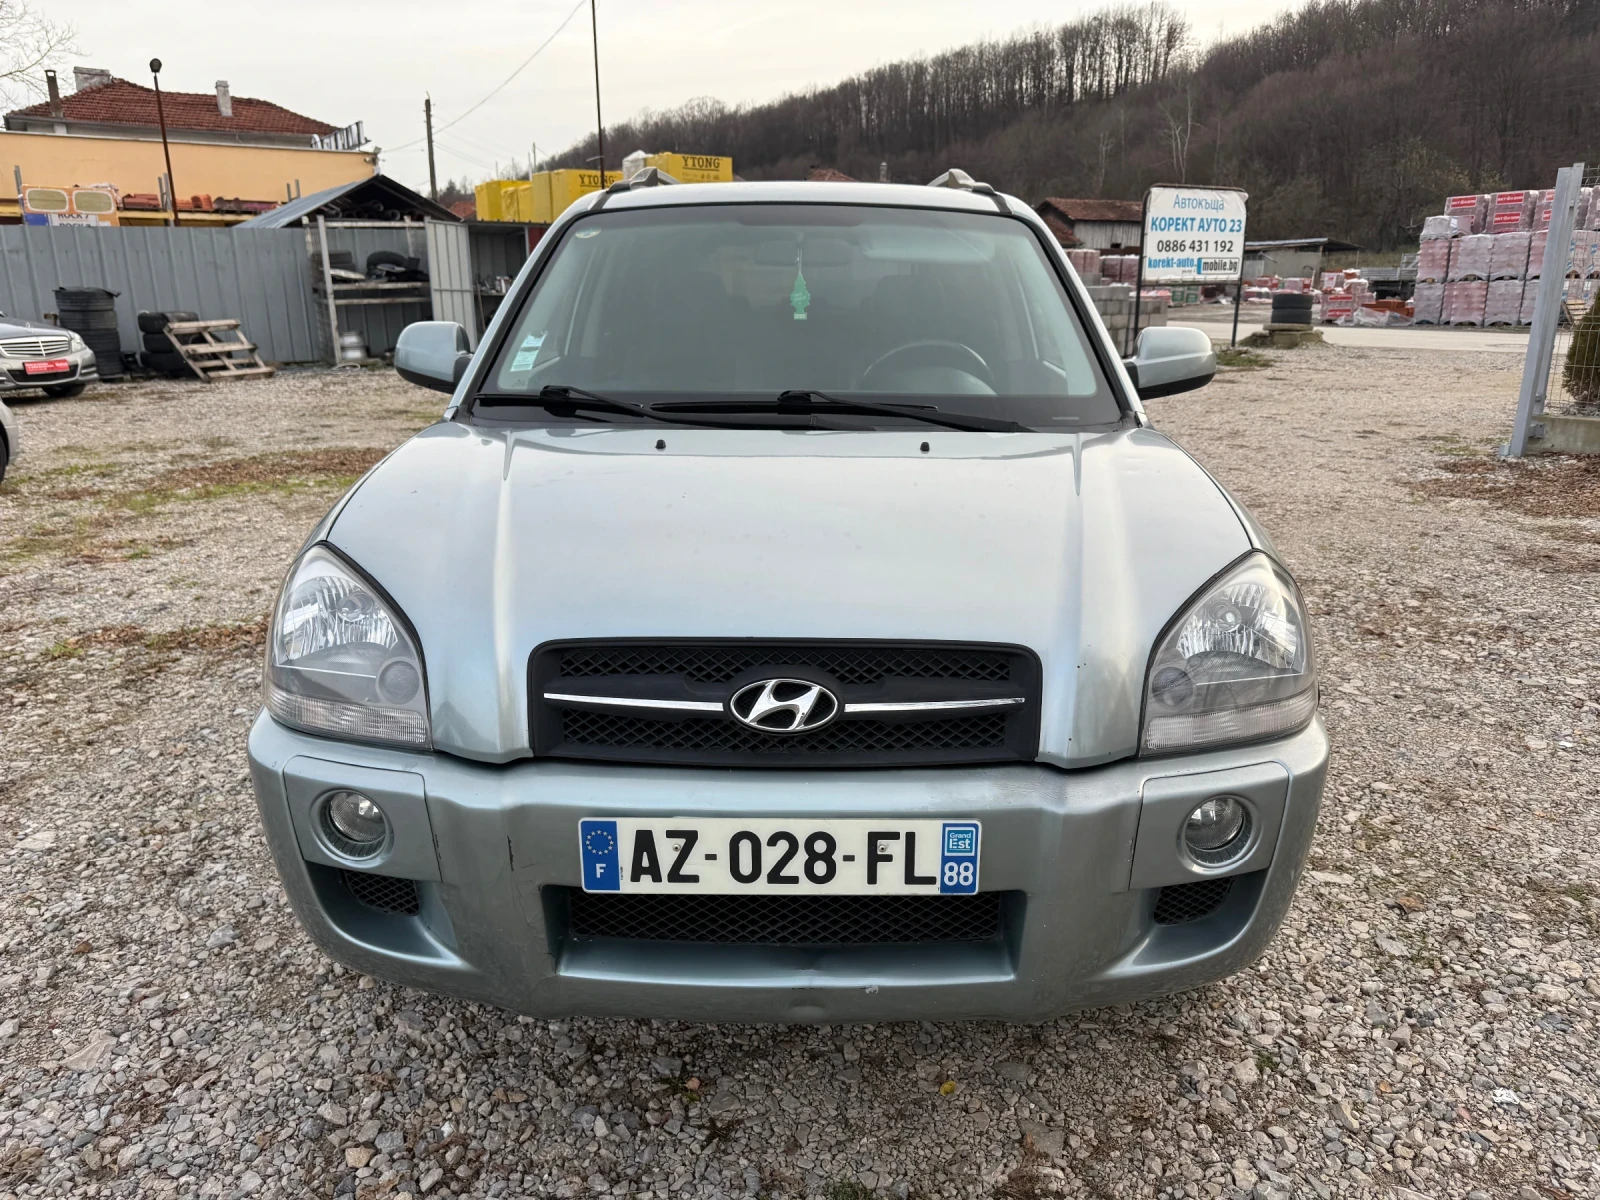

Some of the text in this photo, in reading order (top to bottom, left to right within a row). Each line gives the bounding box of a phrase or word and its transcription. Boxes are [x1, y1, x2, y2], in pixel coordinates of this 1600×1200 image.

[682, 156, 720, 169] YTONG
[1173, 194, 1225, 212] Автокъща
[1151, 217, 1242, 232] КОРЕКТ АУТО 23
[1157, 240, 1234, 252] 0886 431 192
[949, 839, 971, 849] Est
[630, 829, 937, 886] AZ-028-FL
[596, 863, 607, 878] F
[944, 861, 974, 886] 88
